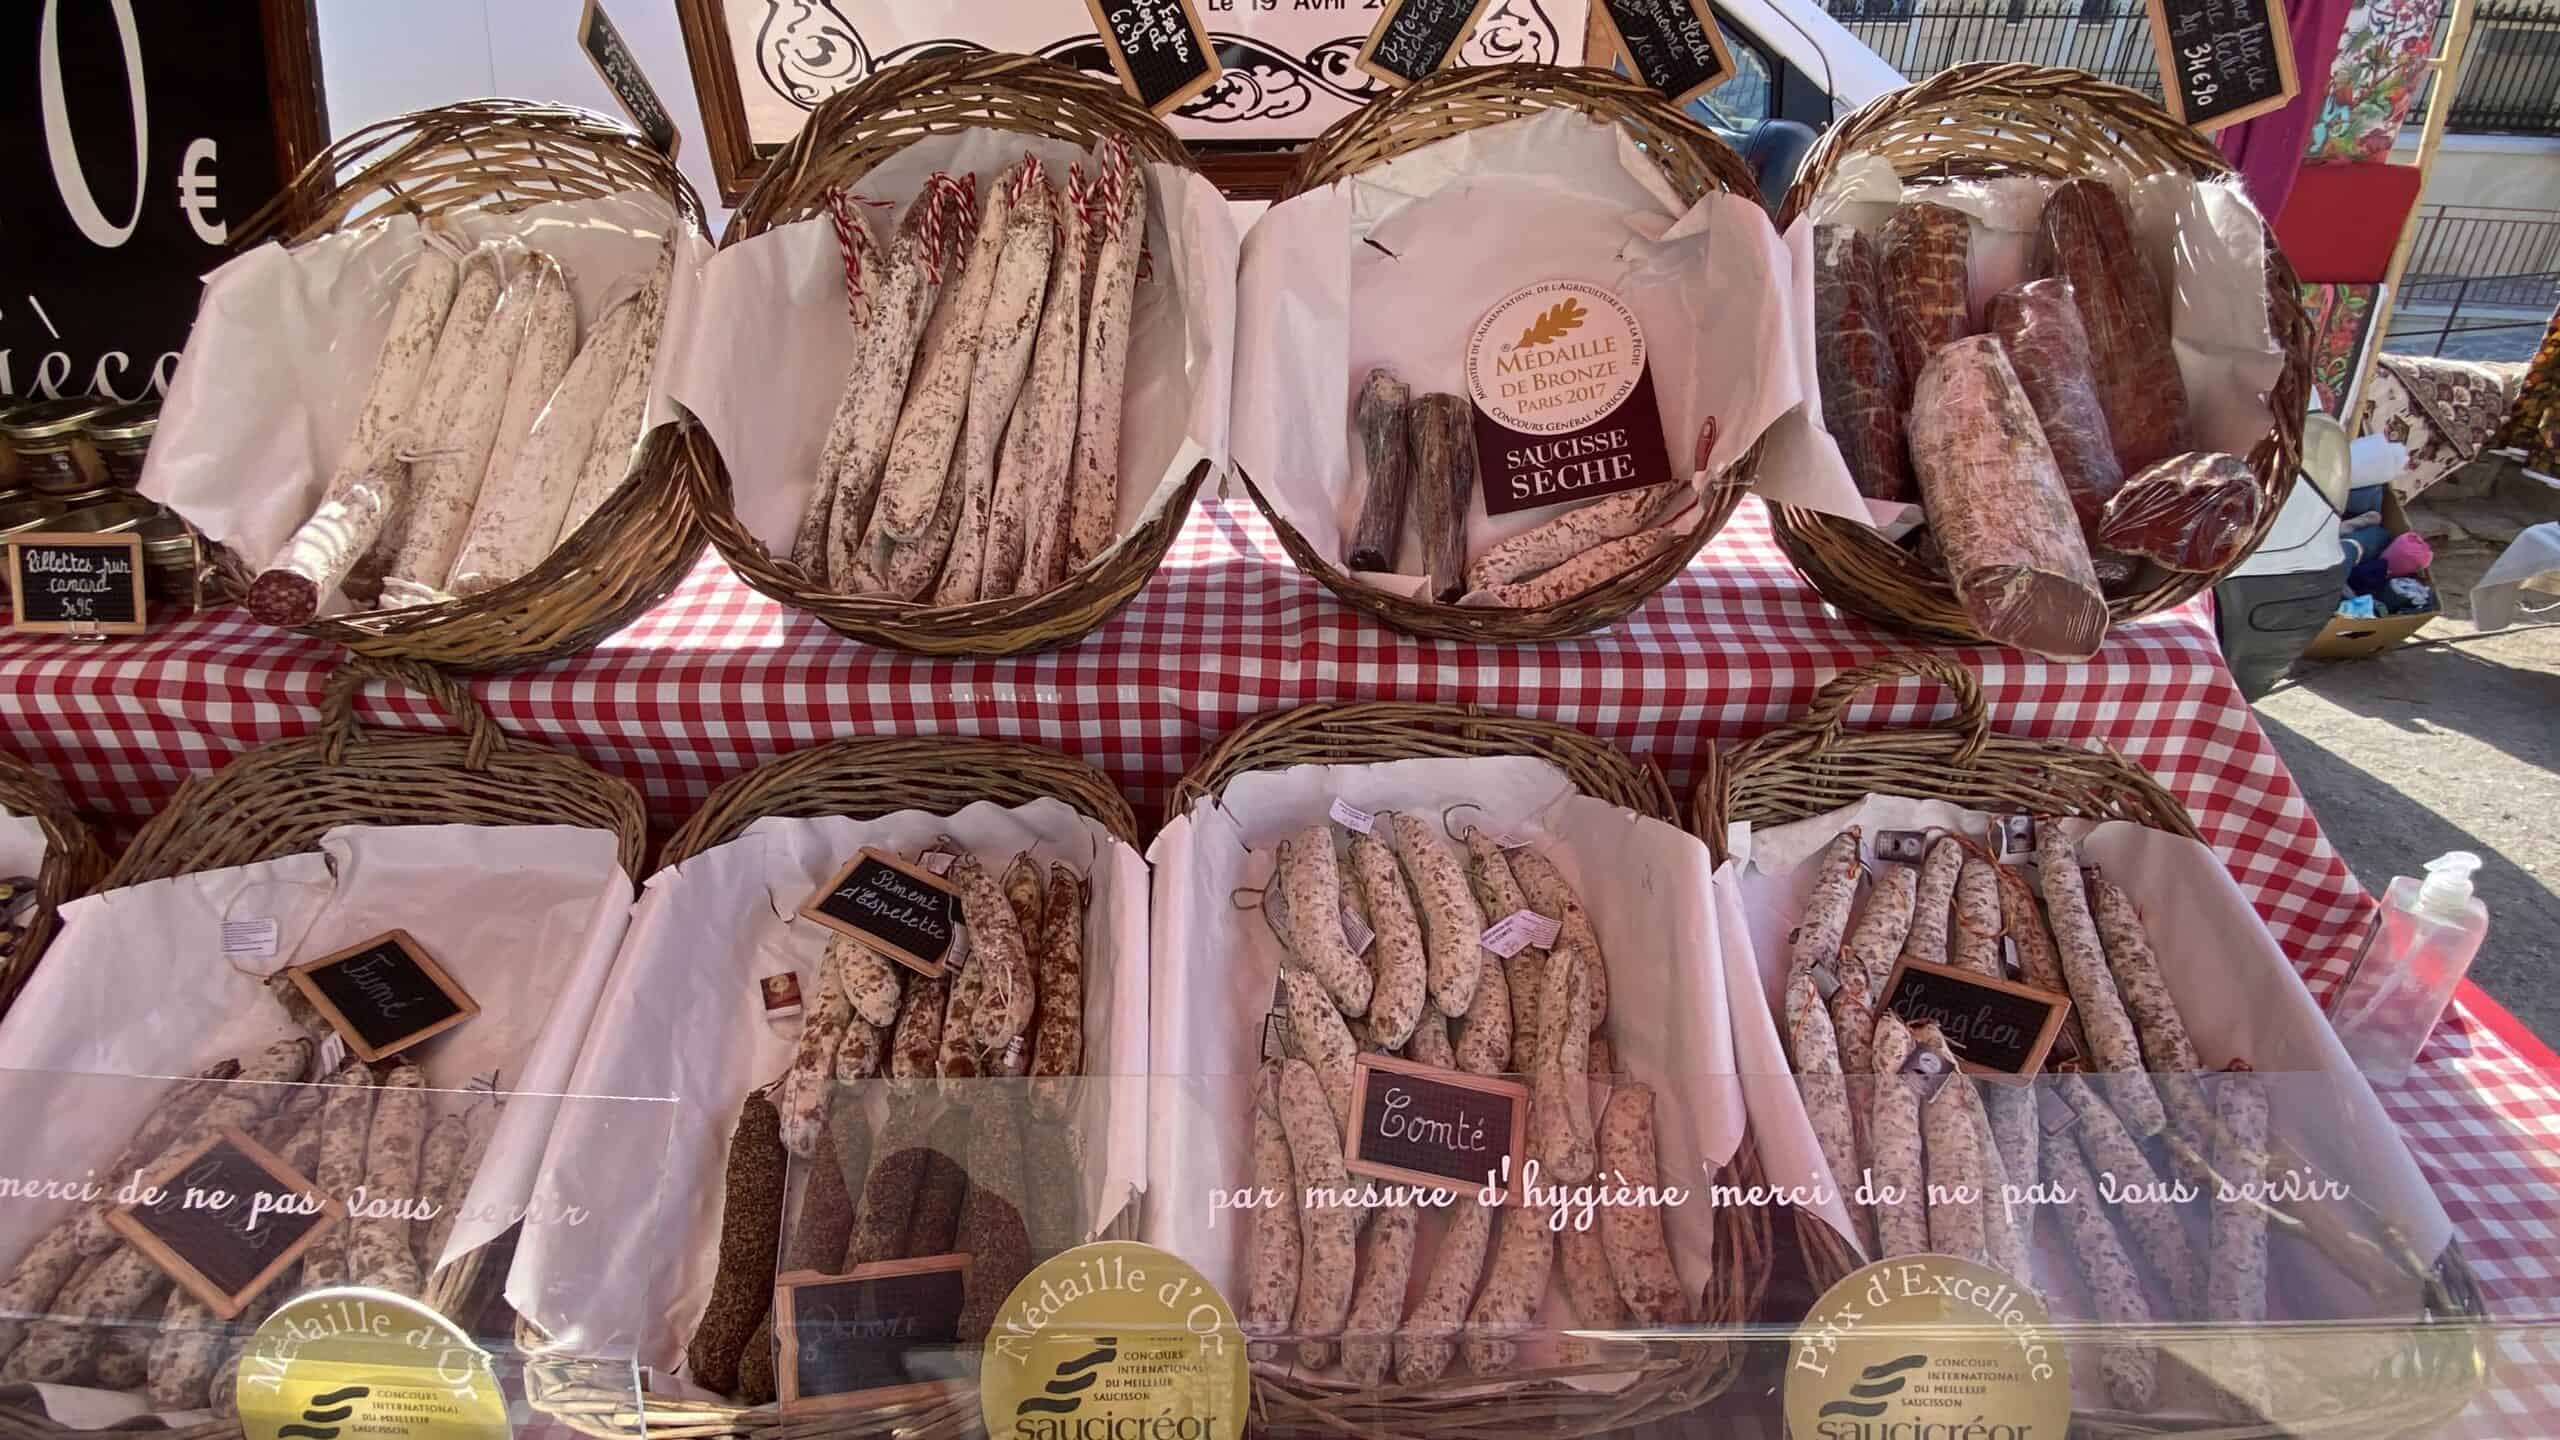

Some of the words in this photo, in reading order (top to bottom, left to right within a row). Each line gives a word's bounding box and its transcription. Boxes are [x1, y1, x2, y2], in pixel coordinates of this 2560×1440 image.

[1472, 342, 1481, 355] DE
[1537, 284, 1550, 295] DE
[1616, 305, 1627, 316] ET
[1625, 313, 1636, 326] DE
[1496, 336, 1617, 377] MÉDAILLE
[1501, 376, 1529, 399] DE
[1532, 361, 1618, 392] BRONZE
[1492, 406, 1545, 432] CONCOURS
[1545, 414, 1593, 432] GÉNÉRAL
[1593, 379, 1633, 417] AGRICOLE
[1518, 393, 1562, 415] PARIS
[1567, 382, 1607, 404] 2017
[1506, 428, 1628, 470] SAUCISSE
[46, 574, 112, 593] canard
[872, 869, 939, 911] Piment
[1380, 1088, 1486, 1152] Comté
[117, 1168, 168, 1207] de
[182, 1185, 237, 1210] ne
[245, 1189, 328, 1232] pas
[1207, 1185, 1285, 1230] par
[1305, 1182, 1458, 1209] mesure
[1477, 1155, 1690, 1232] d'hygiène
[1711, 1172, 1834, 1208] merci
[1855, 1168, 1907, 1206] de
[1928, 1184, 1983, 1206] ne
[2001, 1180, 2078, 1225] pas
[1123, 1350, 1184, 1360] CONCOURS
[1935, 1358, 1999, 1367] CONCOURS
[1105, 1379, 1119, 1388] DU
[1914, 1385, 1929, 1393] DU
[1927, 1371, 2019, 1382] INTERNATIONAL
[1093, 1391, 1151, 1401] SAUCISSON
[1901, 1398, 1962, 1408] SAUCISSON
[1014, 1408, 1217, 1440] saucicréor
